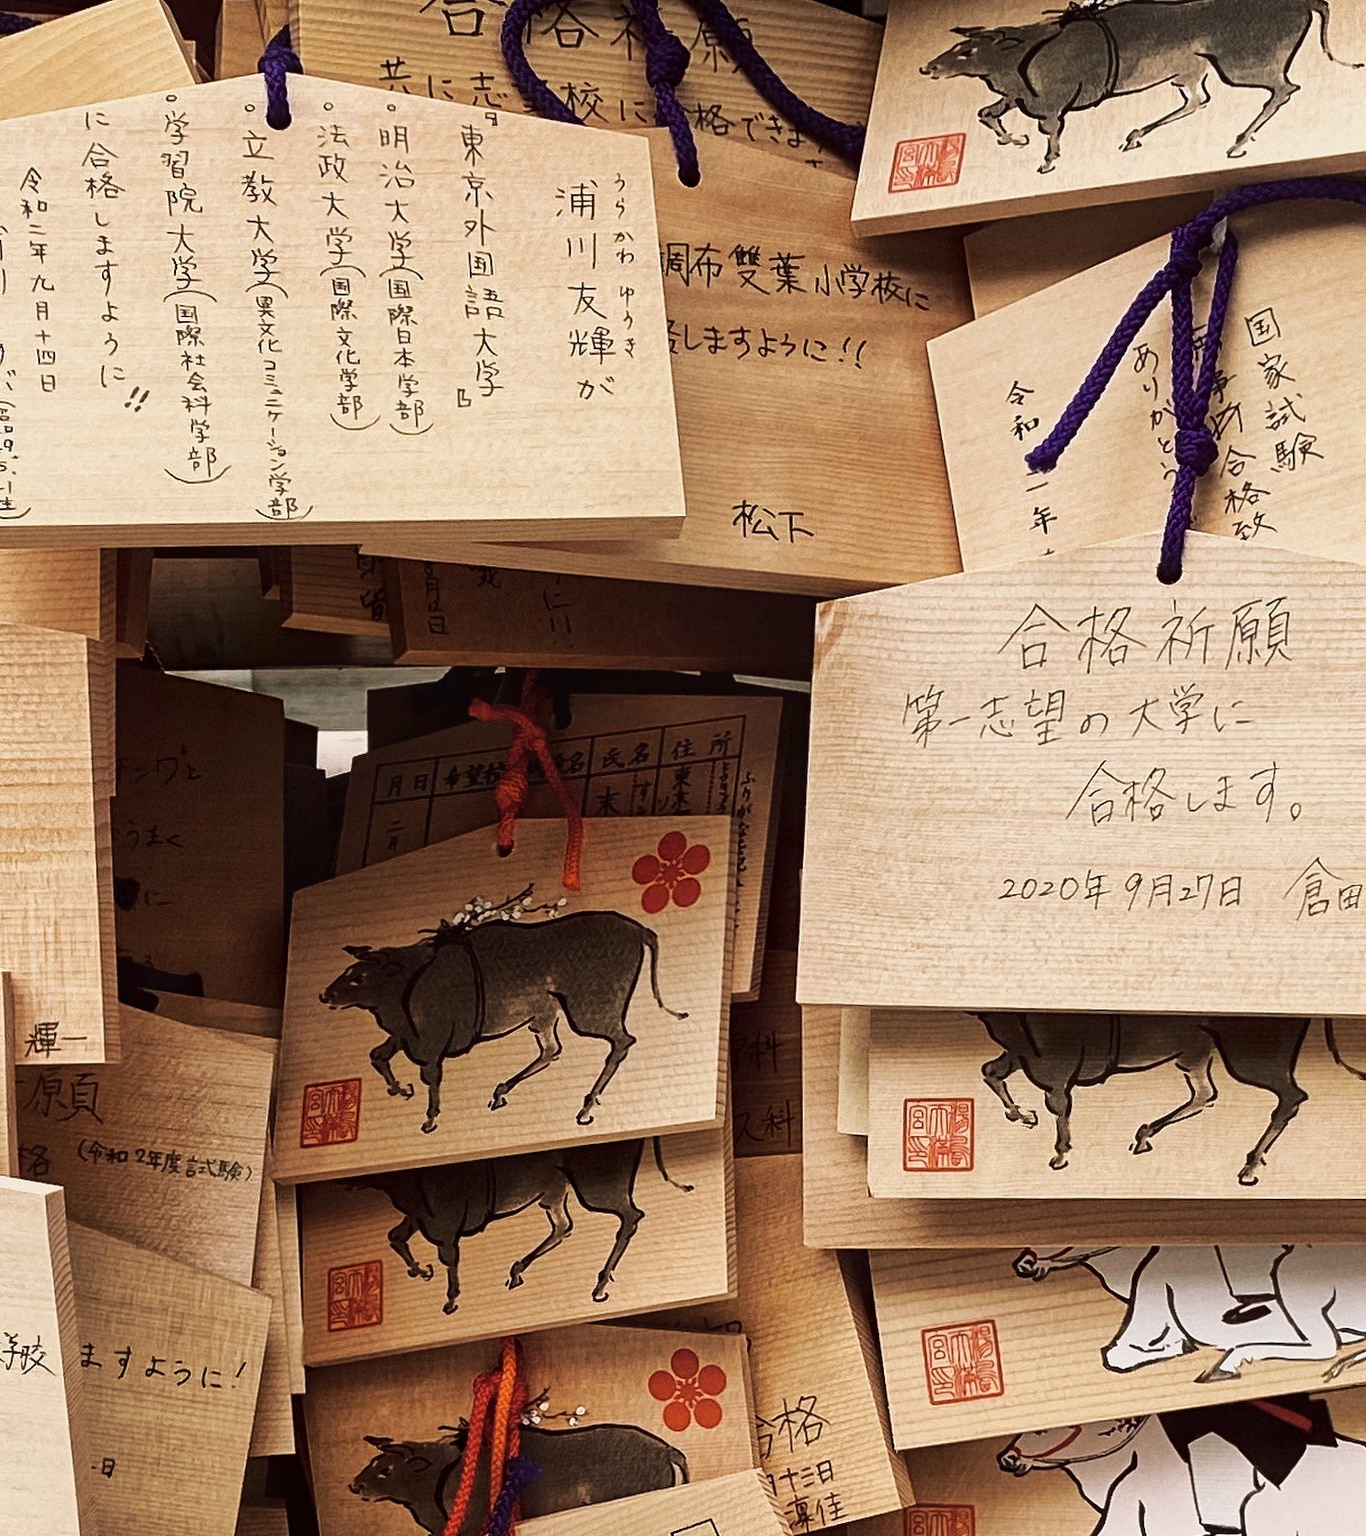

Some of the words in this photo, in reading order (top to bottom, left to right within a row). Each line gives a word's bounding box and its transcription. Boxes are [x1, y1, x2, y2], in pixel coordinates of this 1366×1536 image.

[733, 500, 814, 543] 松下
[997, 598, 1294, 674] 合格祈願
[903, 685, 1253, 748] 第一志望の大学に
